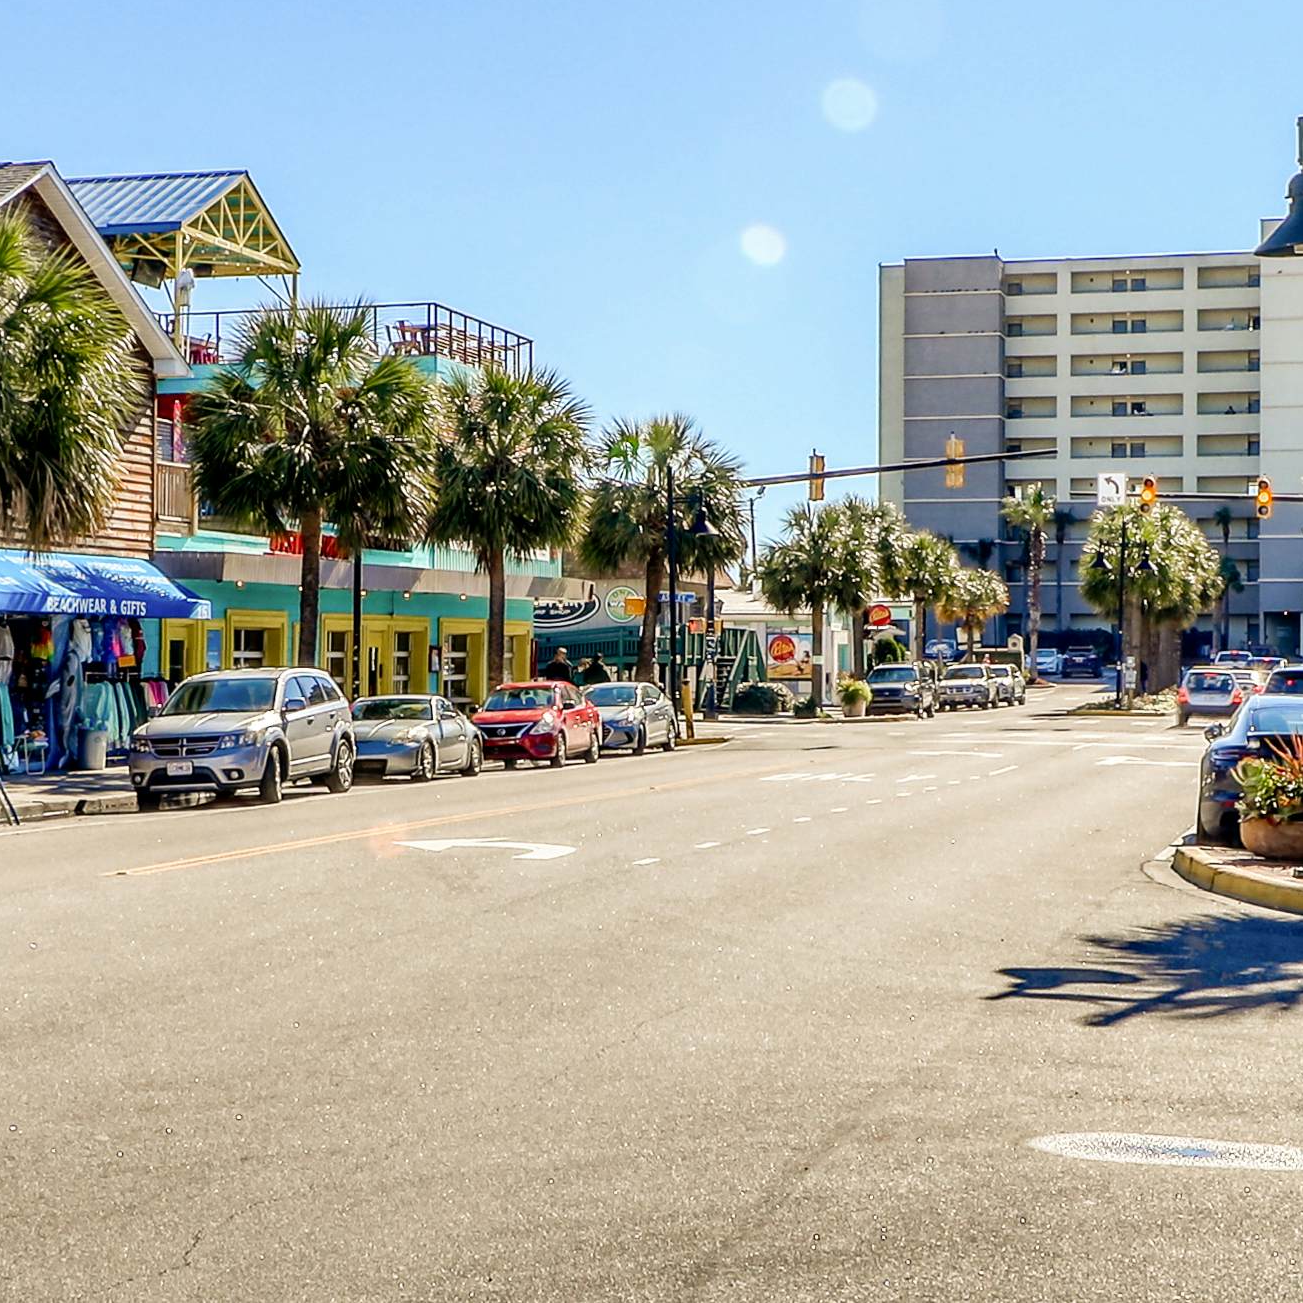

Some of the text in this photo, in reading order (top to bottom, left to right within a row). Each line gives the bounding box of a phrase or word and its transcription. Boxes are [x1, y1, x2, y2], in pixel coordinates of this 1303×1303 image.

[46, 596, 107, 614] BEACHWEAR
[110, 599, 118, 614] &
[120, 600, 147, 616] GIFTS
